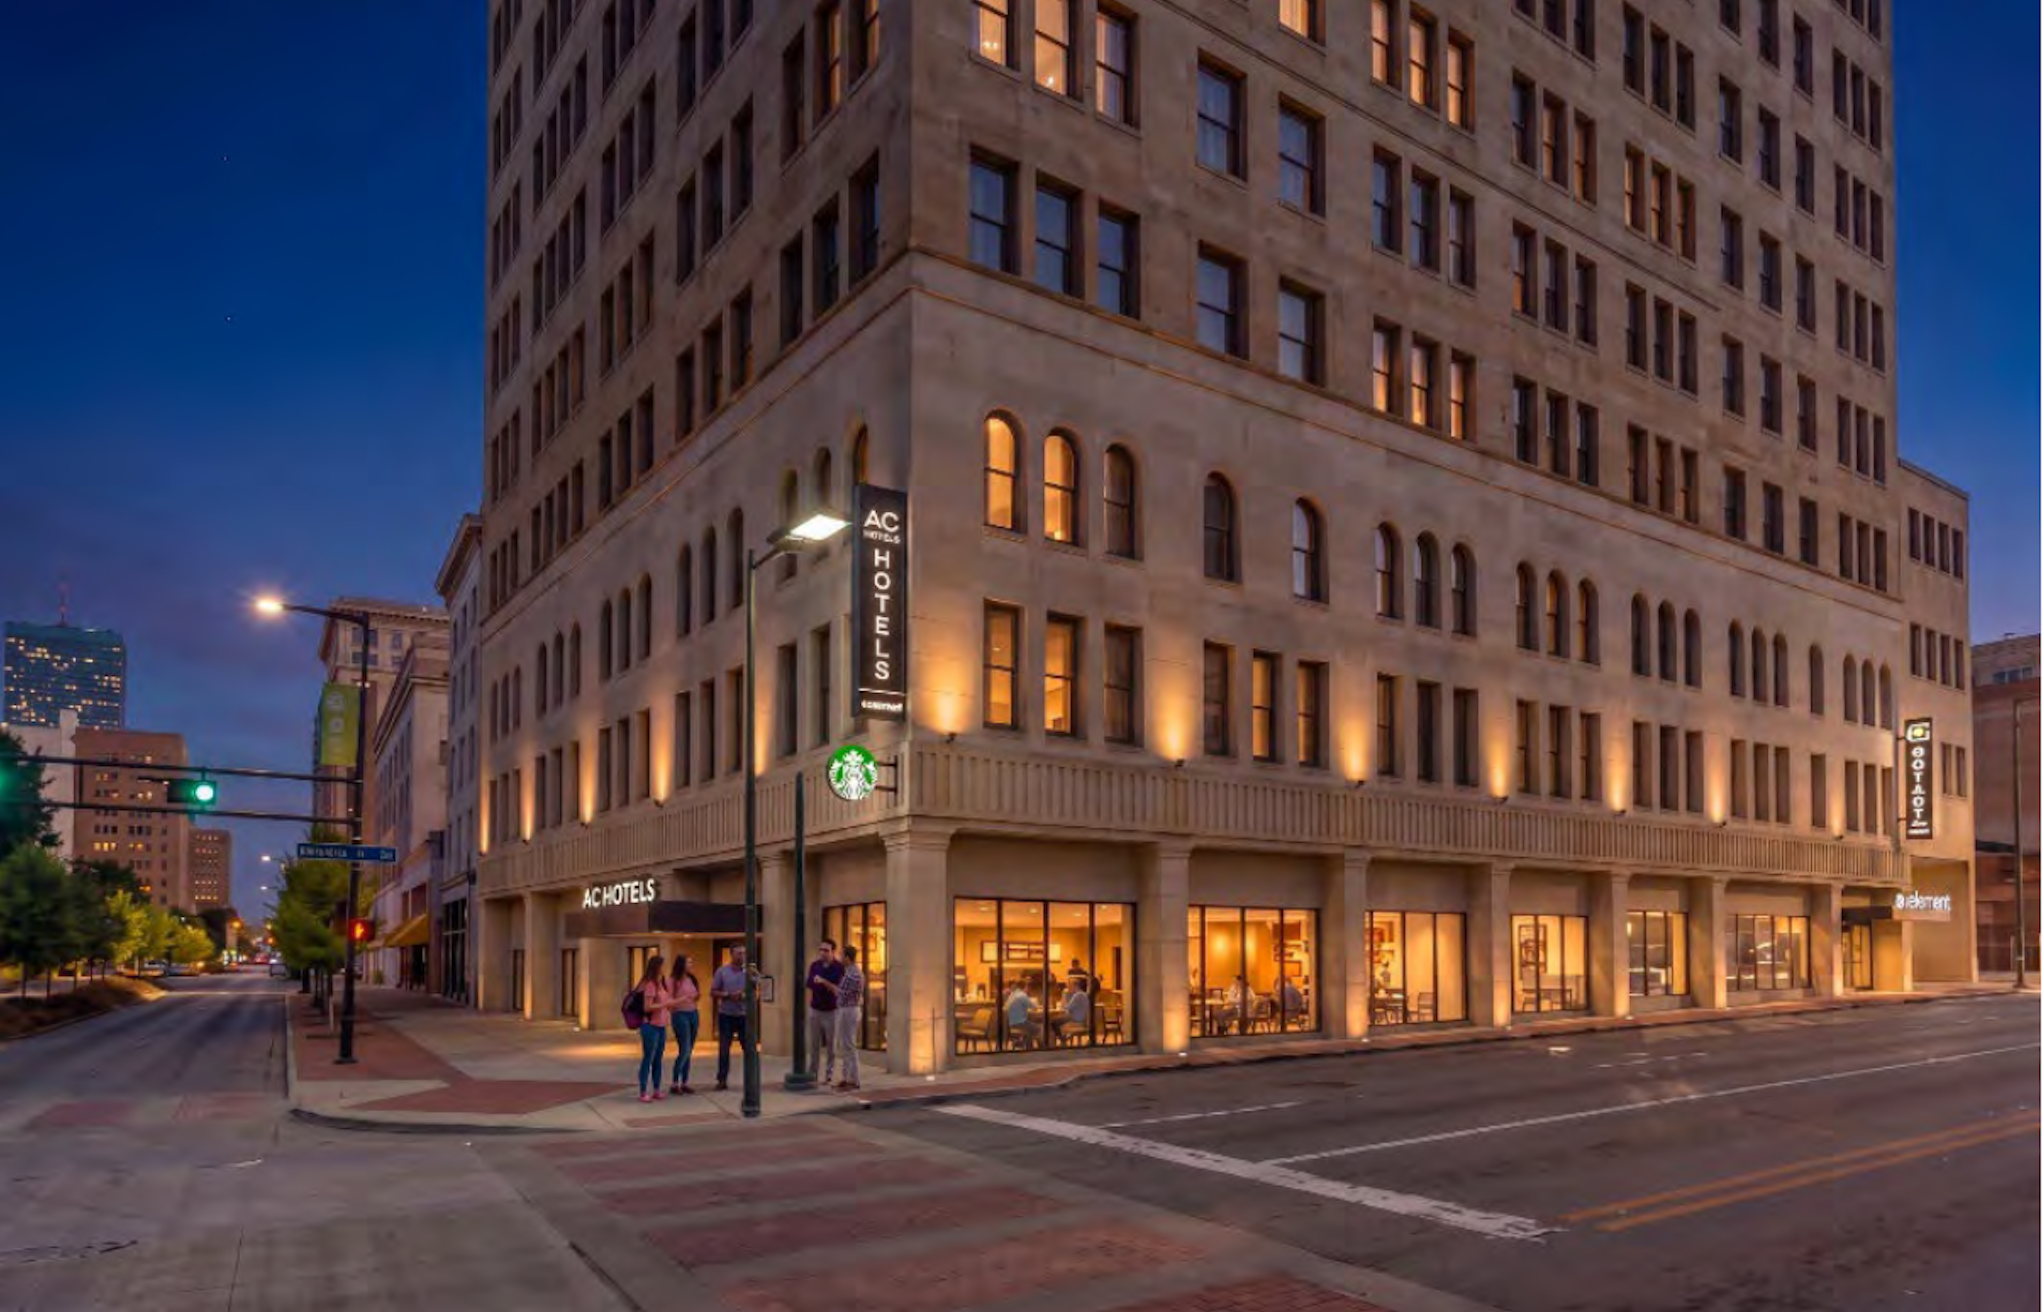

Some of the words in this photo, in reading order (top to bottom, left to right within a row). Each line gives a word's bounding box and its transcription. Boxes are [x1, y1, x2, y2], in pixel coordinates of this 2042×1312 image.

[863, 510, 899, 532] AC
[874, 549, 892, 680] HOTELS
[582, 887, 601, 908] AC
[602, 878, 655, 906] HOTELS
